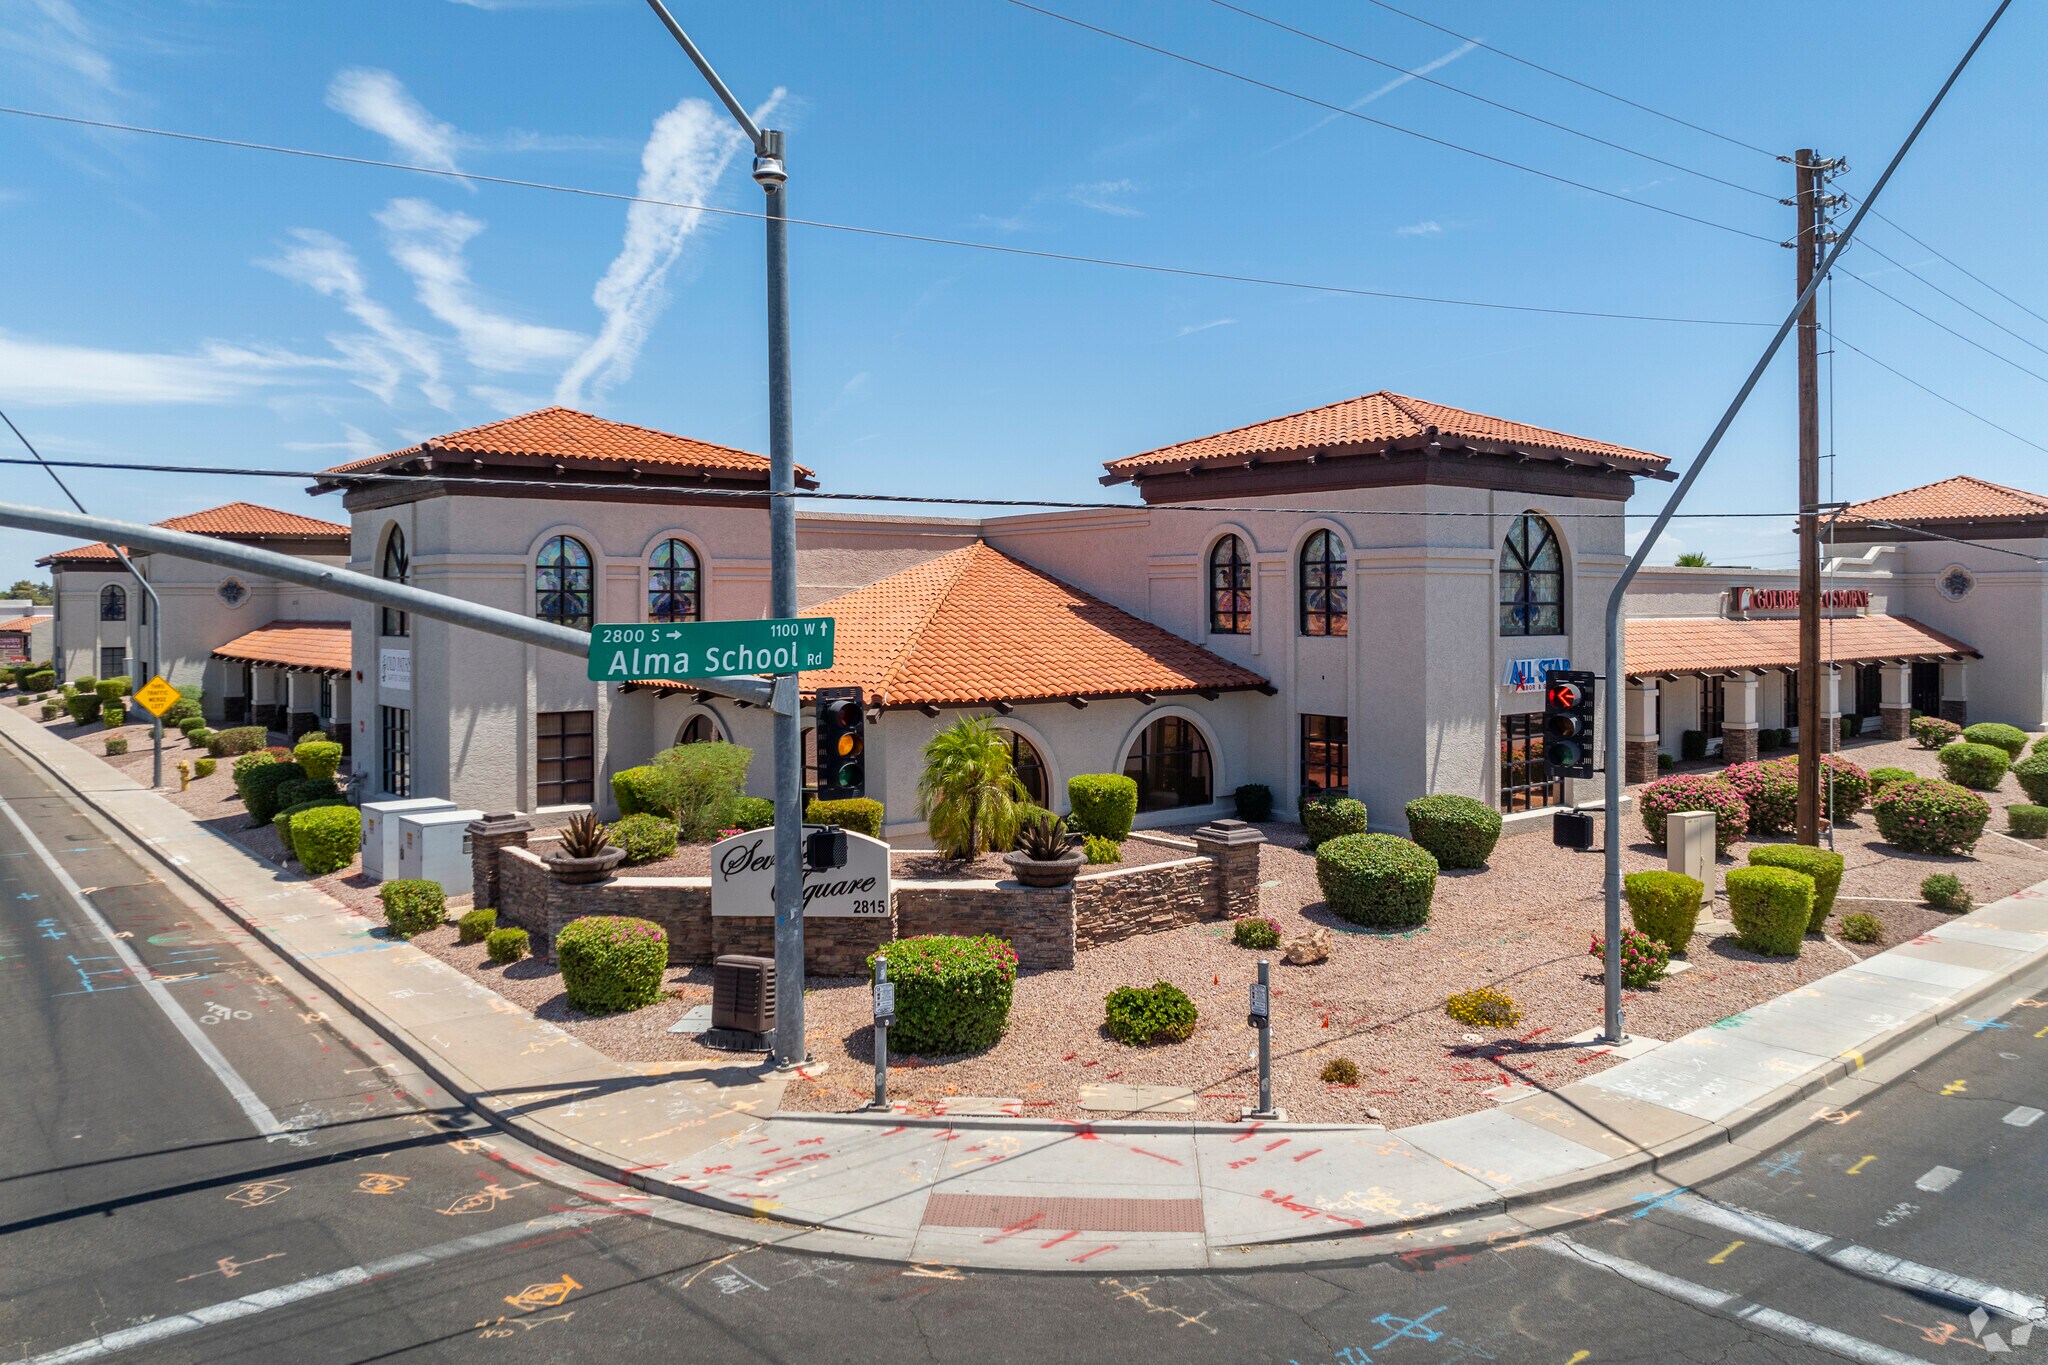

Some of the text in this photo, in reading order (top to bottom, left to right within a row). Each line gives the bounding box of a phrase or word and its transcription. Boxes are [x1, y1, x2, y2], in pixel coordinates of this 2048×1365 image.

[1757, 589, 1800, 609] GOLDBE
[1825, 589, 1869, 608] OSBORNE
[602, 629, 660, 643] 2800 S
[770, 623, 815, 637] 1100 W
[607, 641, 822, 676] Alma School Rd
[771, 869, 876, 911] quare
[853, 900, 885, 914] 2815
